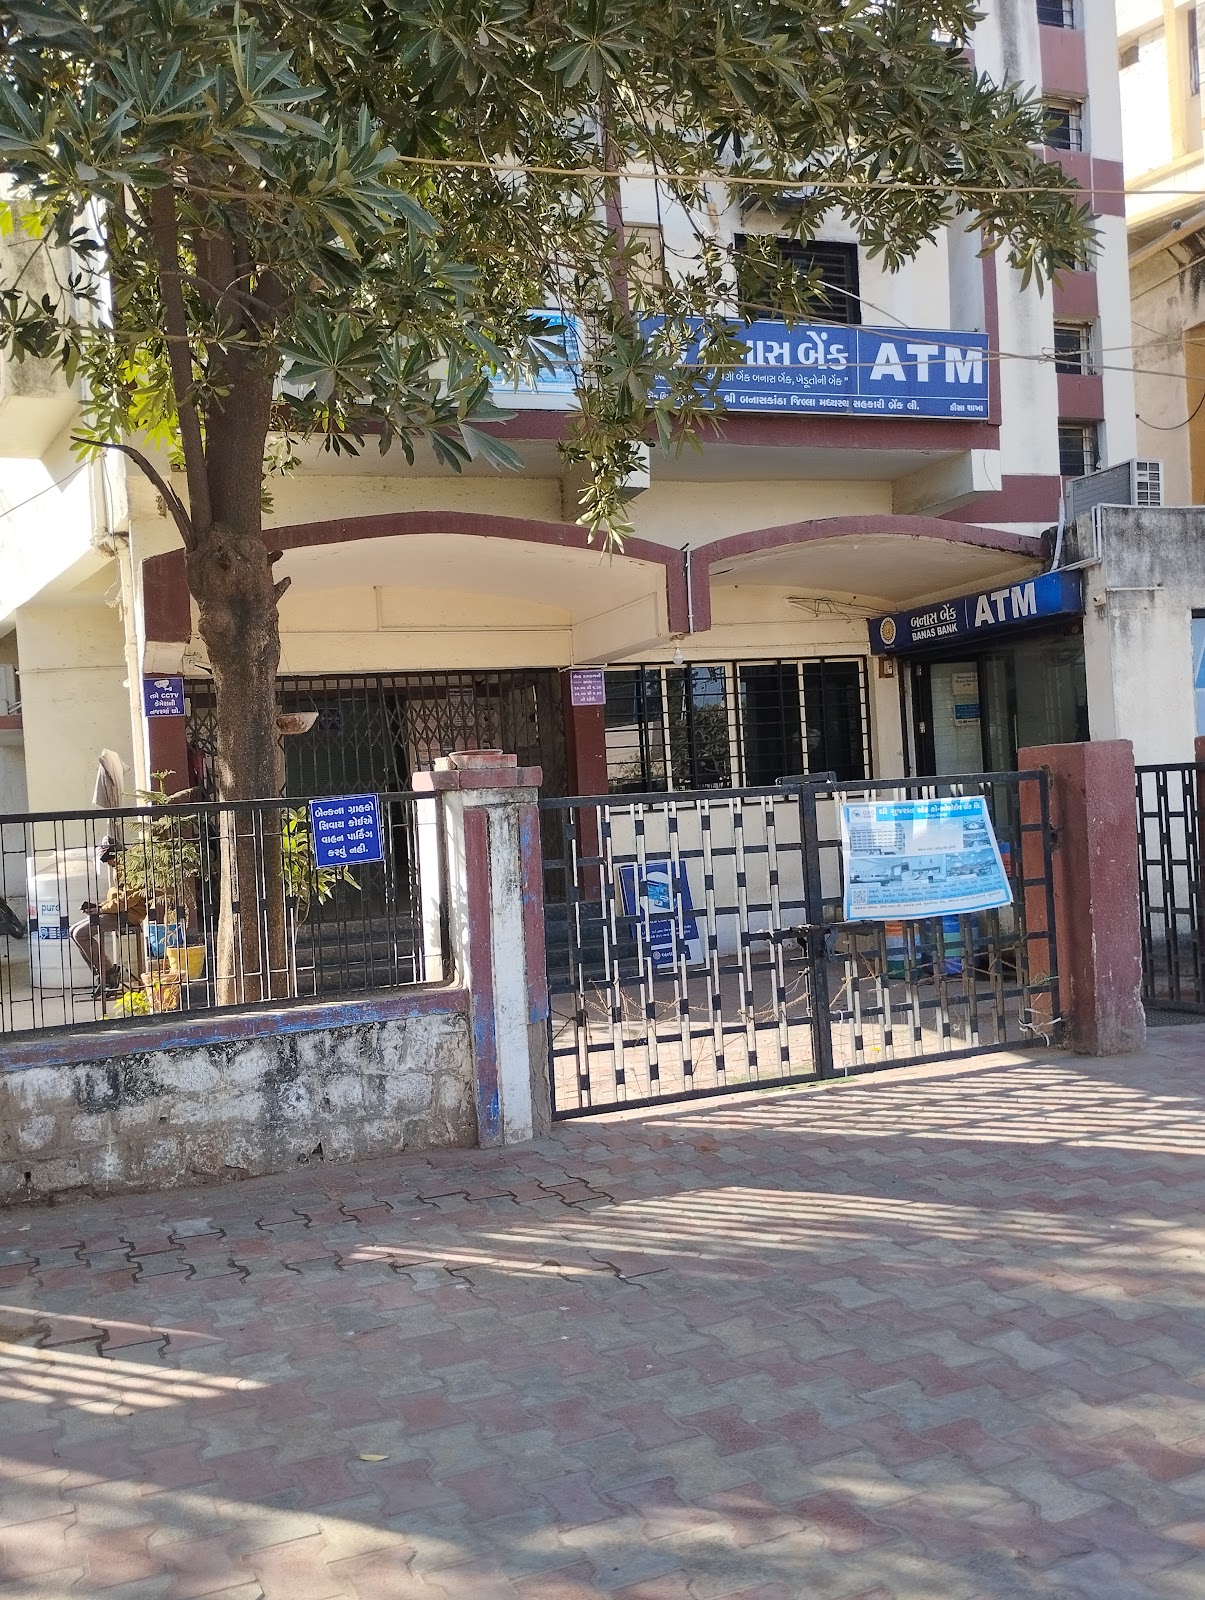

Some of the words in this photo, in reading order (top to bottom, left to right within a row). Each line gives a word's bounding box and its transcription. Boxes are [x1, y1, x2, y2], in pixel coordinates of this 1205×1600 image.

[797, 331, 849, 371] બેંક
[869, 342, 983, 384] ATM
[735, 370, 751, 382] બેંક
[752, 373, 776, 384] બનાસ
[723, 392, 736, 405] શ્રી
[853, 398, 885, 409] સહકારી
[888, 398, 903, 410] બેંક
[975, 582, 1038, 628] ATM
[911, 610, 938, 628] બનાસ
[939, 603, 957, 621] બેંક
[911, 627, 936, 642] BANAS
[937, 622, 958, 637] BANK
[315, 806, 345, 818] બેન્કના
[347, 801, 374, 815] ગ્રાહકો
[318, 820, 345, 831] સિવાય
[347, 815, 373, 827] કોઈએ
[321, 833, 344, 844] વાહન
[327, 845, 347, 858] કરવું
